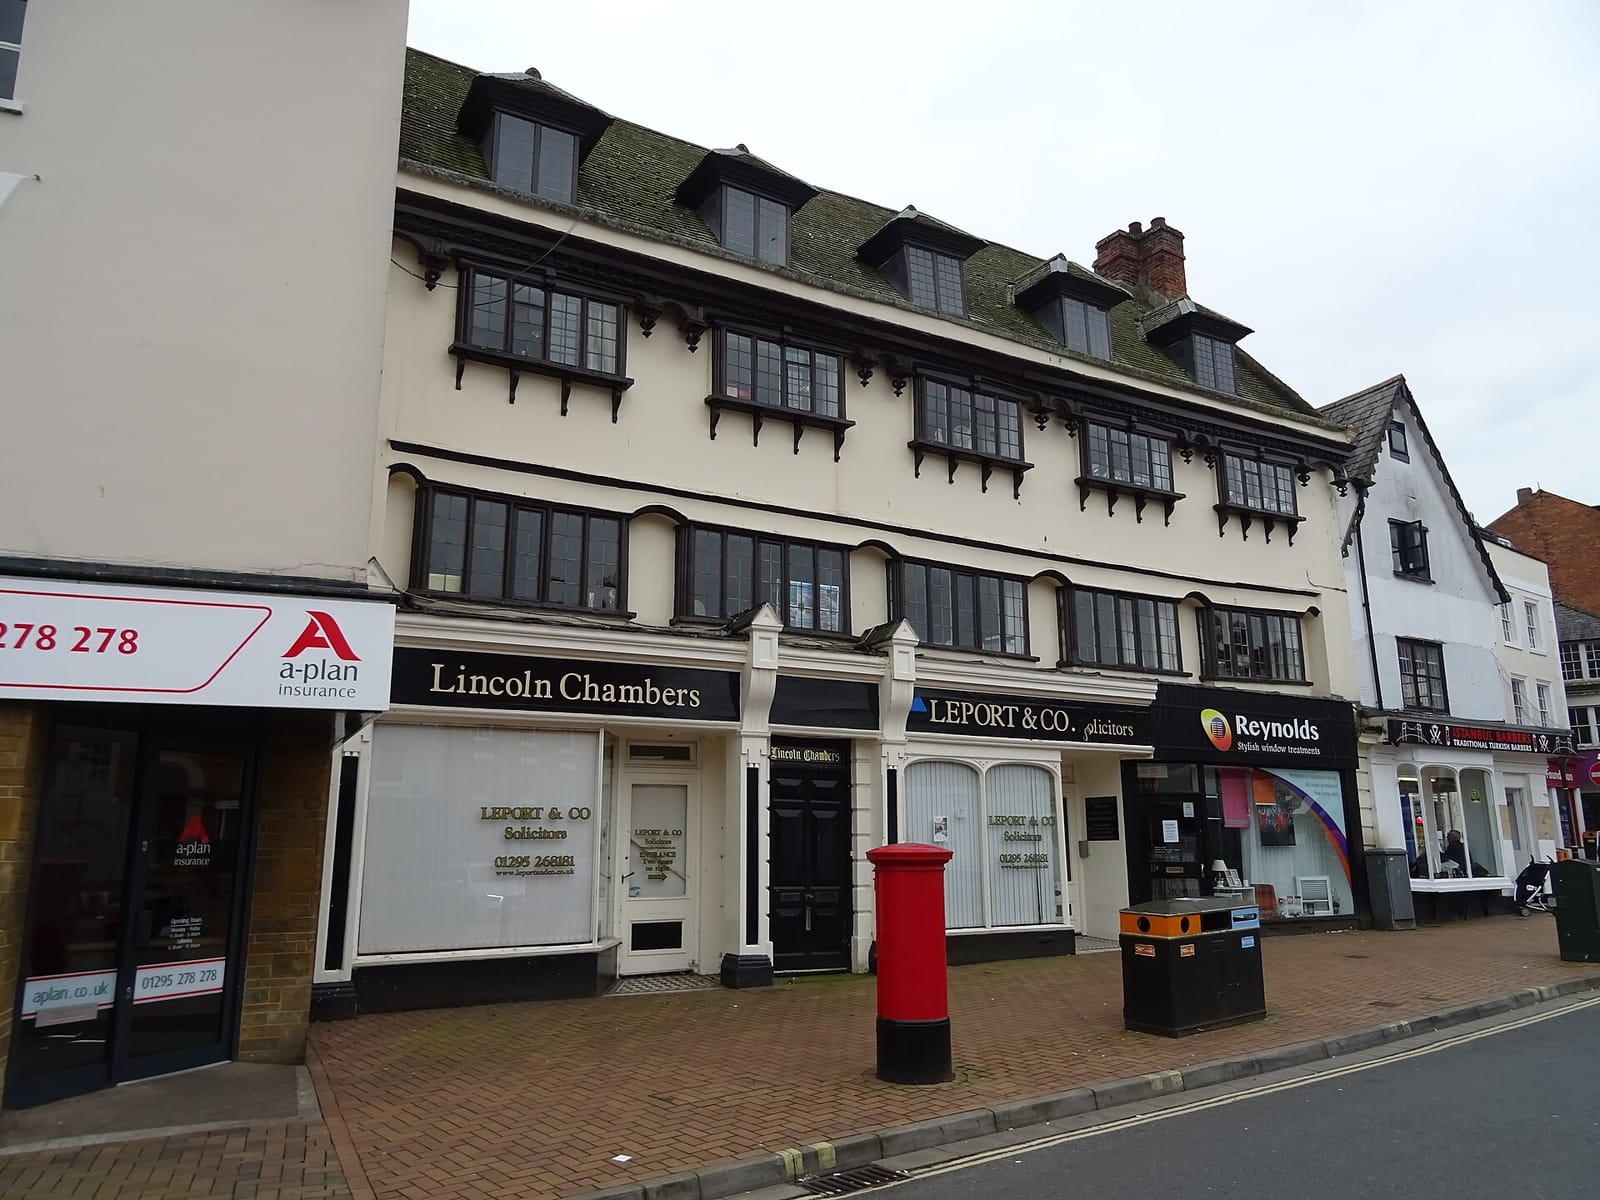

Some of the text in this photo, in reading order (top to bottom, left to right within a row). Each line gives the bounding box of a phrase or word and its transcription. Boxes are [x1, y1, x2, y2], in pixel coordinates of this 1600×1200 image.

[71, 626, 139, 655] 278
[279, 659, 358, 684] a-plan
[278, 684, 356, 699] insurance
[430, 663, 701, 708] Lincoln Chambers
[929, 699, 1076, 732] LEPORT & CO.
[1235, 715, 1320, 740] Reynolds
[1453, 727, 1532, 744] ISTANBUL BARBERS
[1237, 741, 1321, 755] Stylish window treatments
[1453, 739, 1532, 752] TRADITIONAL TURKISH BARBERS
[771, 746, 840, 762] Lincoln Chambers
[481, 807, 591, 820] LEPORT & CO
[988, 816, 1026, 826] LEPORT
[1029, 816, 1039, 826] &
[504, 827, 567, 840] Solicitors
[1004, 831, 1042, 842] Solicitors
[176, 841, 211, 855] a-plan
[174, 858, 210, 866] insurance
[494, 856, 575, 868] 01295 268181
[1000, 854, 1021, 863] 01295
[142, 970, 217, 990] 01295 278 278
[32, 982, 108, 1005] aplan.co.uk
